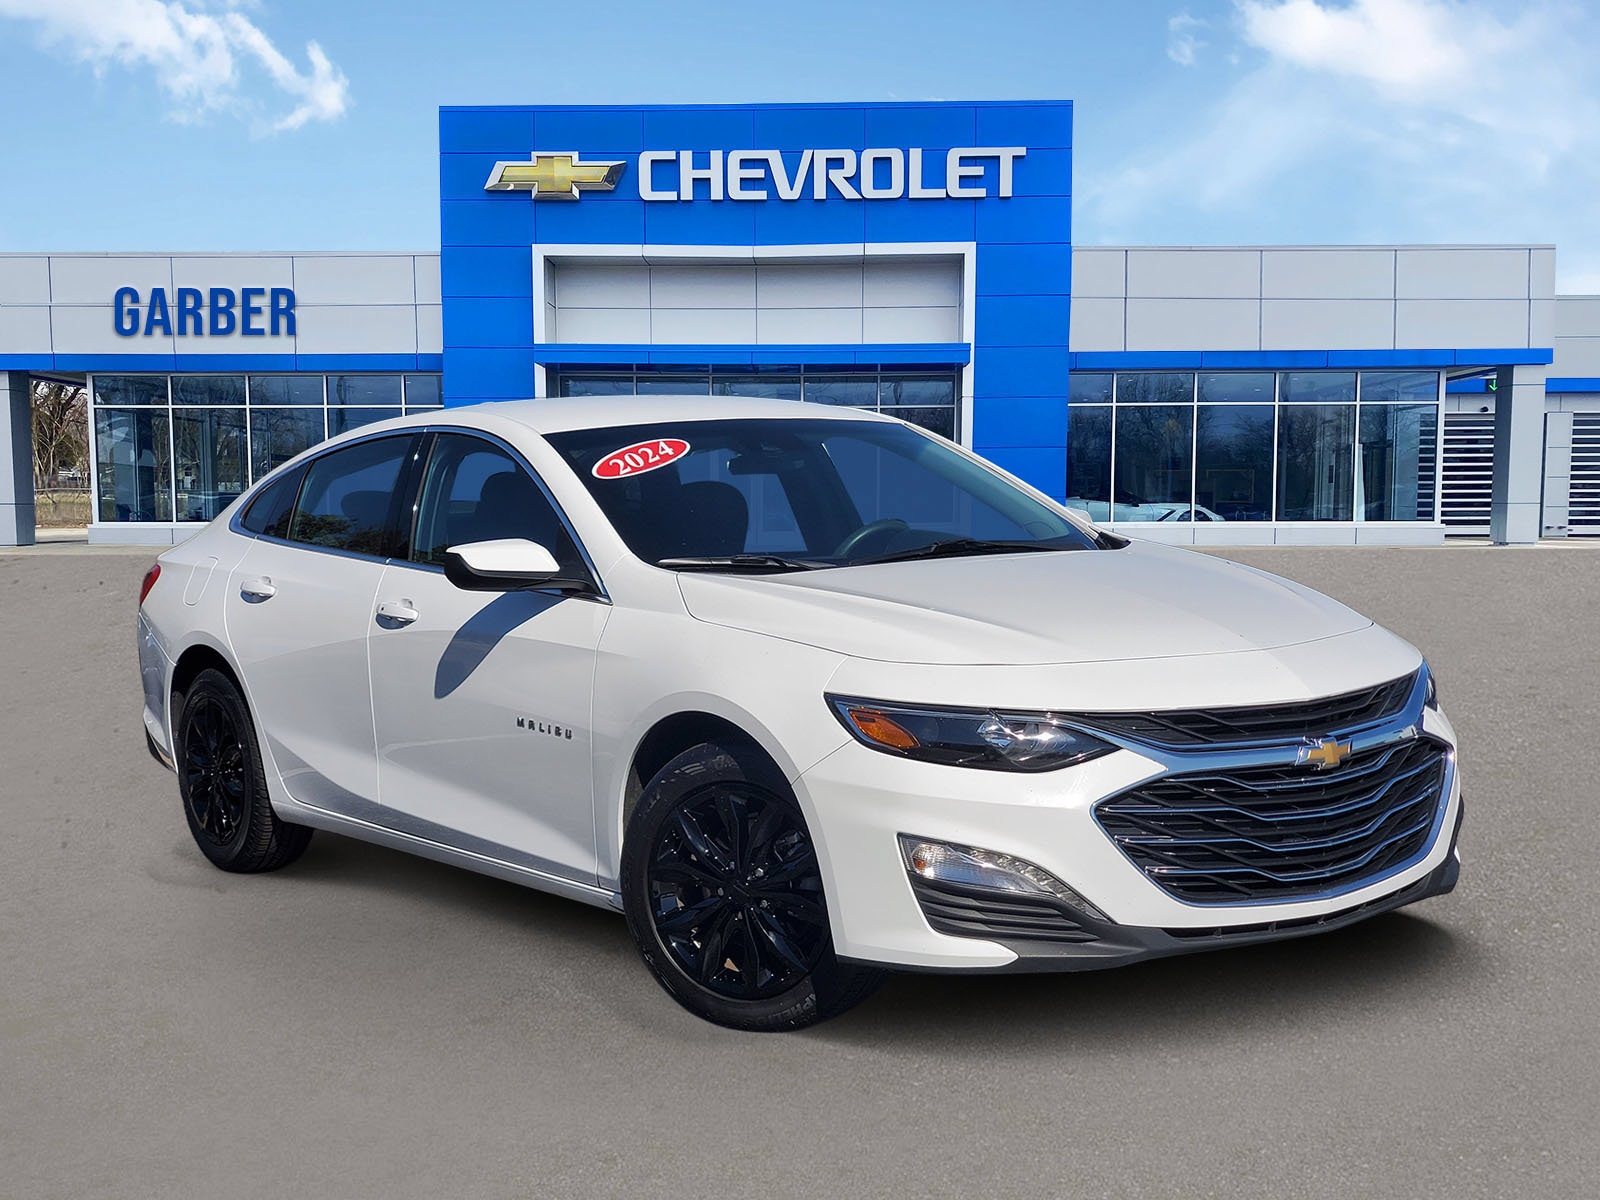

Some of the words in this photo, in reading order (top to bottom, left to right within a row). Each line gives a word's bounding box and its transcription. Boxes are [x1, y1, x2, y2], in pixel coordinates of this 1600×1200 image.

[637, 146, 1027, 202] CHEVROLET
[114, 286, 297, 337] GARBER
[609, 440, 675, 475] 2024
[516, 716, 573, 740] MALIBU
